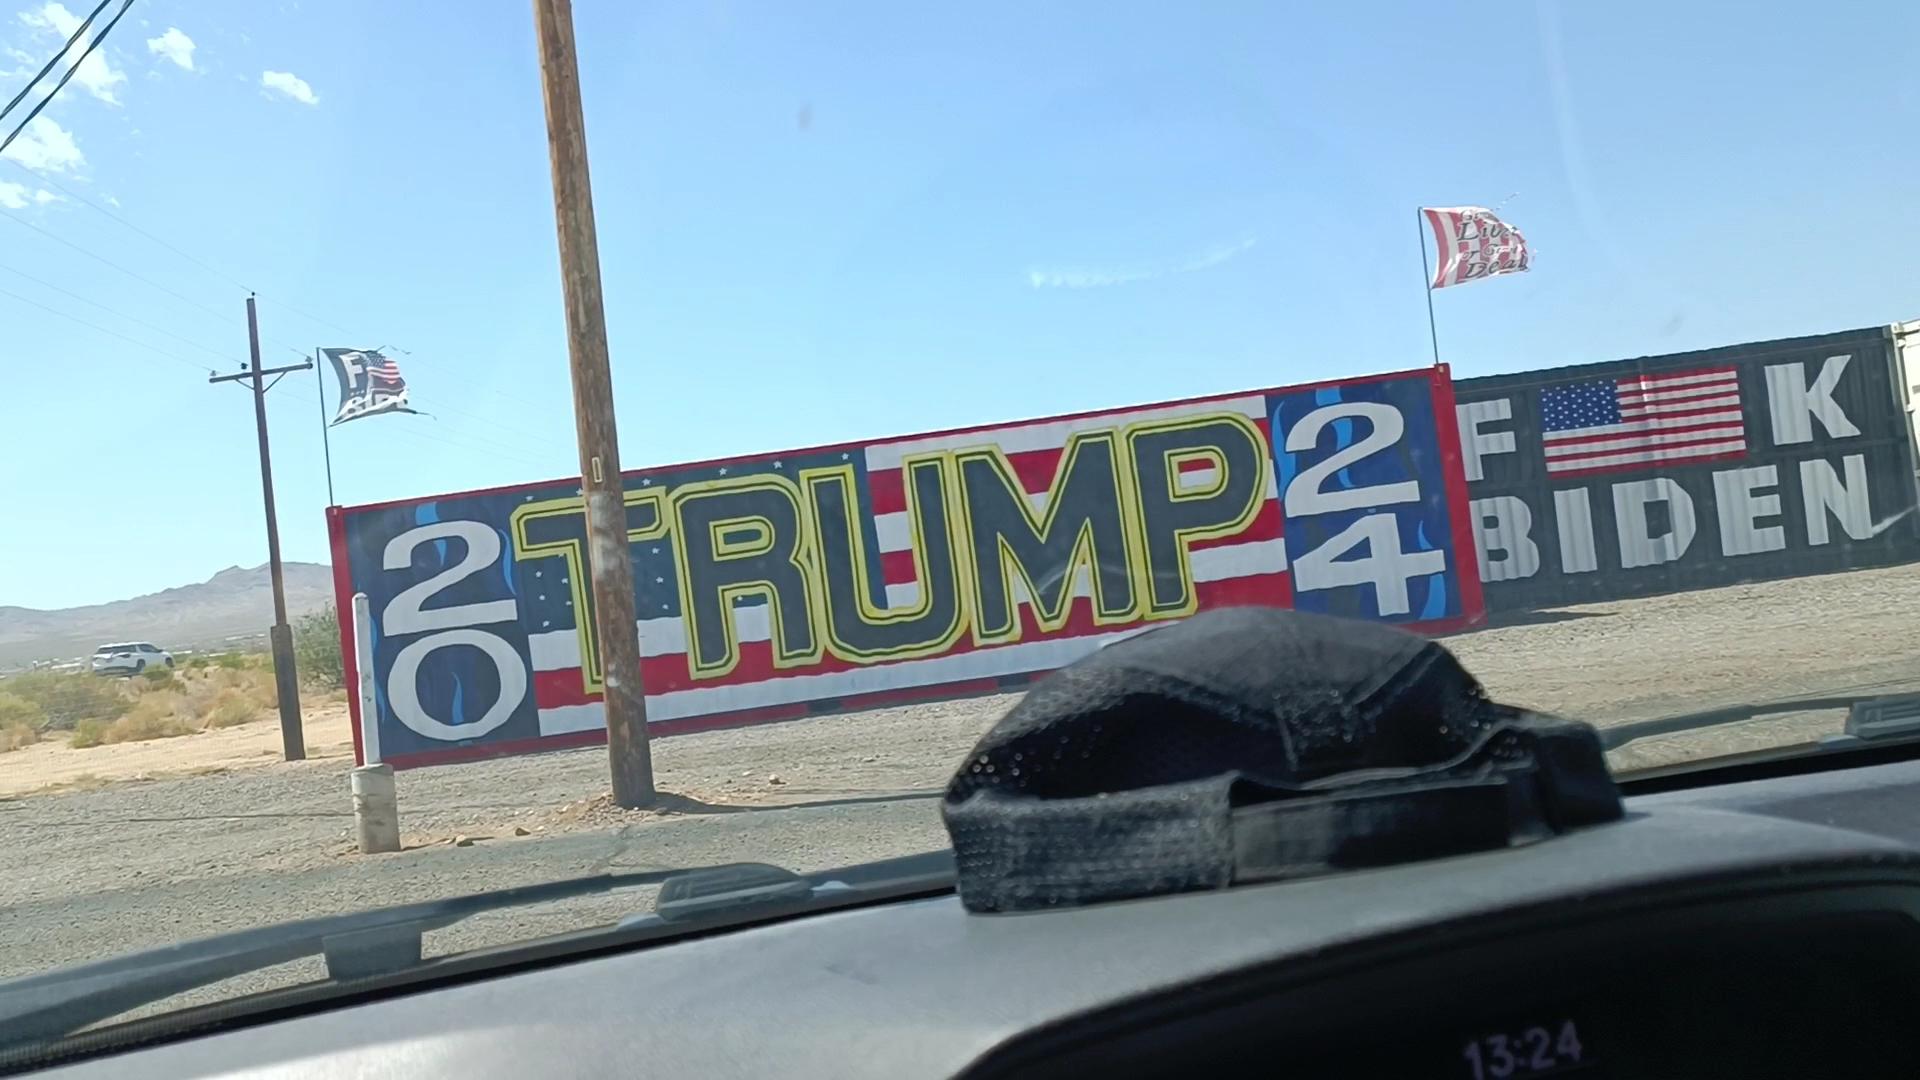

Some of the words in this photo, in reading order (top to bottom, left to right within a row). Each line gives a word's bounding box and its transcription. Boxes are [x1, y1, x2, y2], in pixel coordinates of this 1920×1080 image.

[1456, 398, 1516, 482] F
[1764, 354, 1862, 446] K
[510, 411, 1271, 695] TRUMP
[1469, 453, 1873, 583] BIDEN
[1463, 1019, 1583, 1080] 13:24
